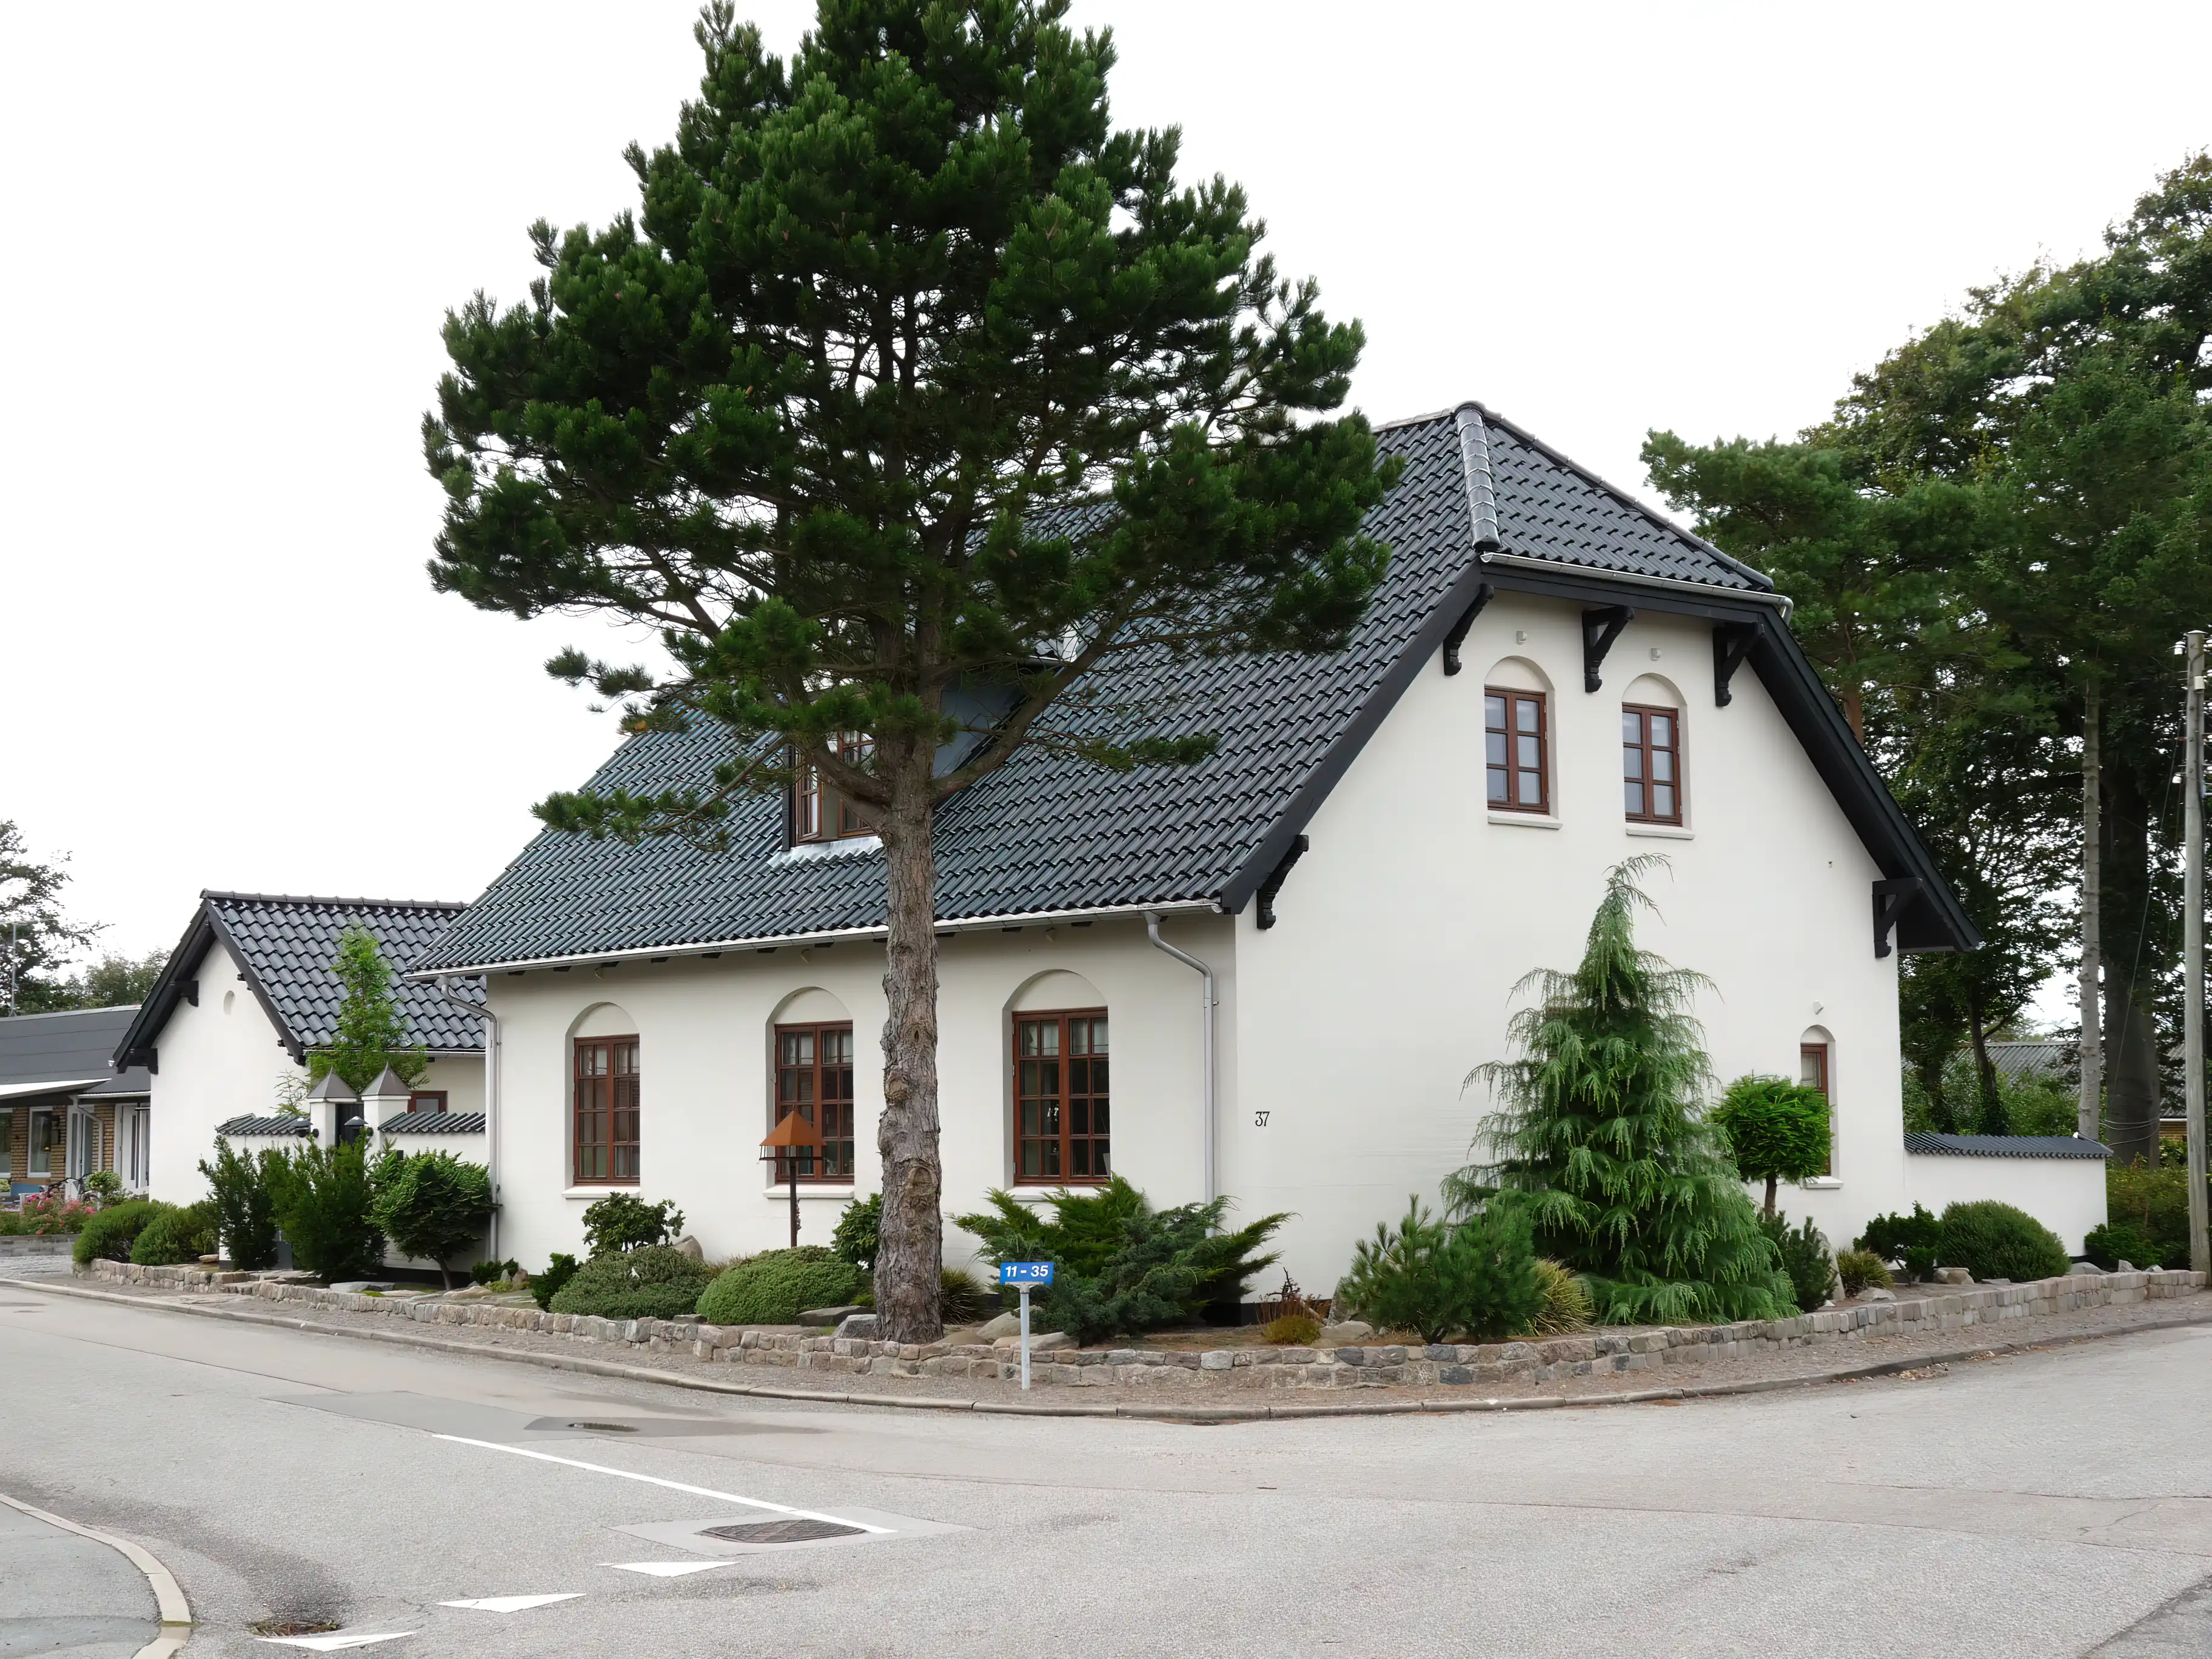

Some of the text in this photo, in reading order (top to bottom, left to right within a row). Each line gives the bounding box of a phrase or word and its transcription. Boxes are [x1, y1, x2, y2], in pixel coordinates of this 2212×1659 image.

[1255, 1111, 1270, 1127] 37
[1005, 1265, 1017, 1277] 11
[1031, 1265, 1048, 1277] 35
